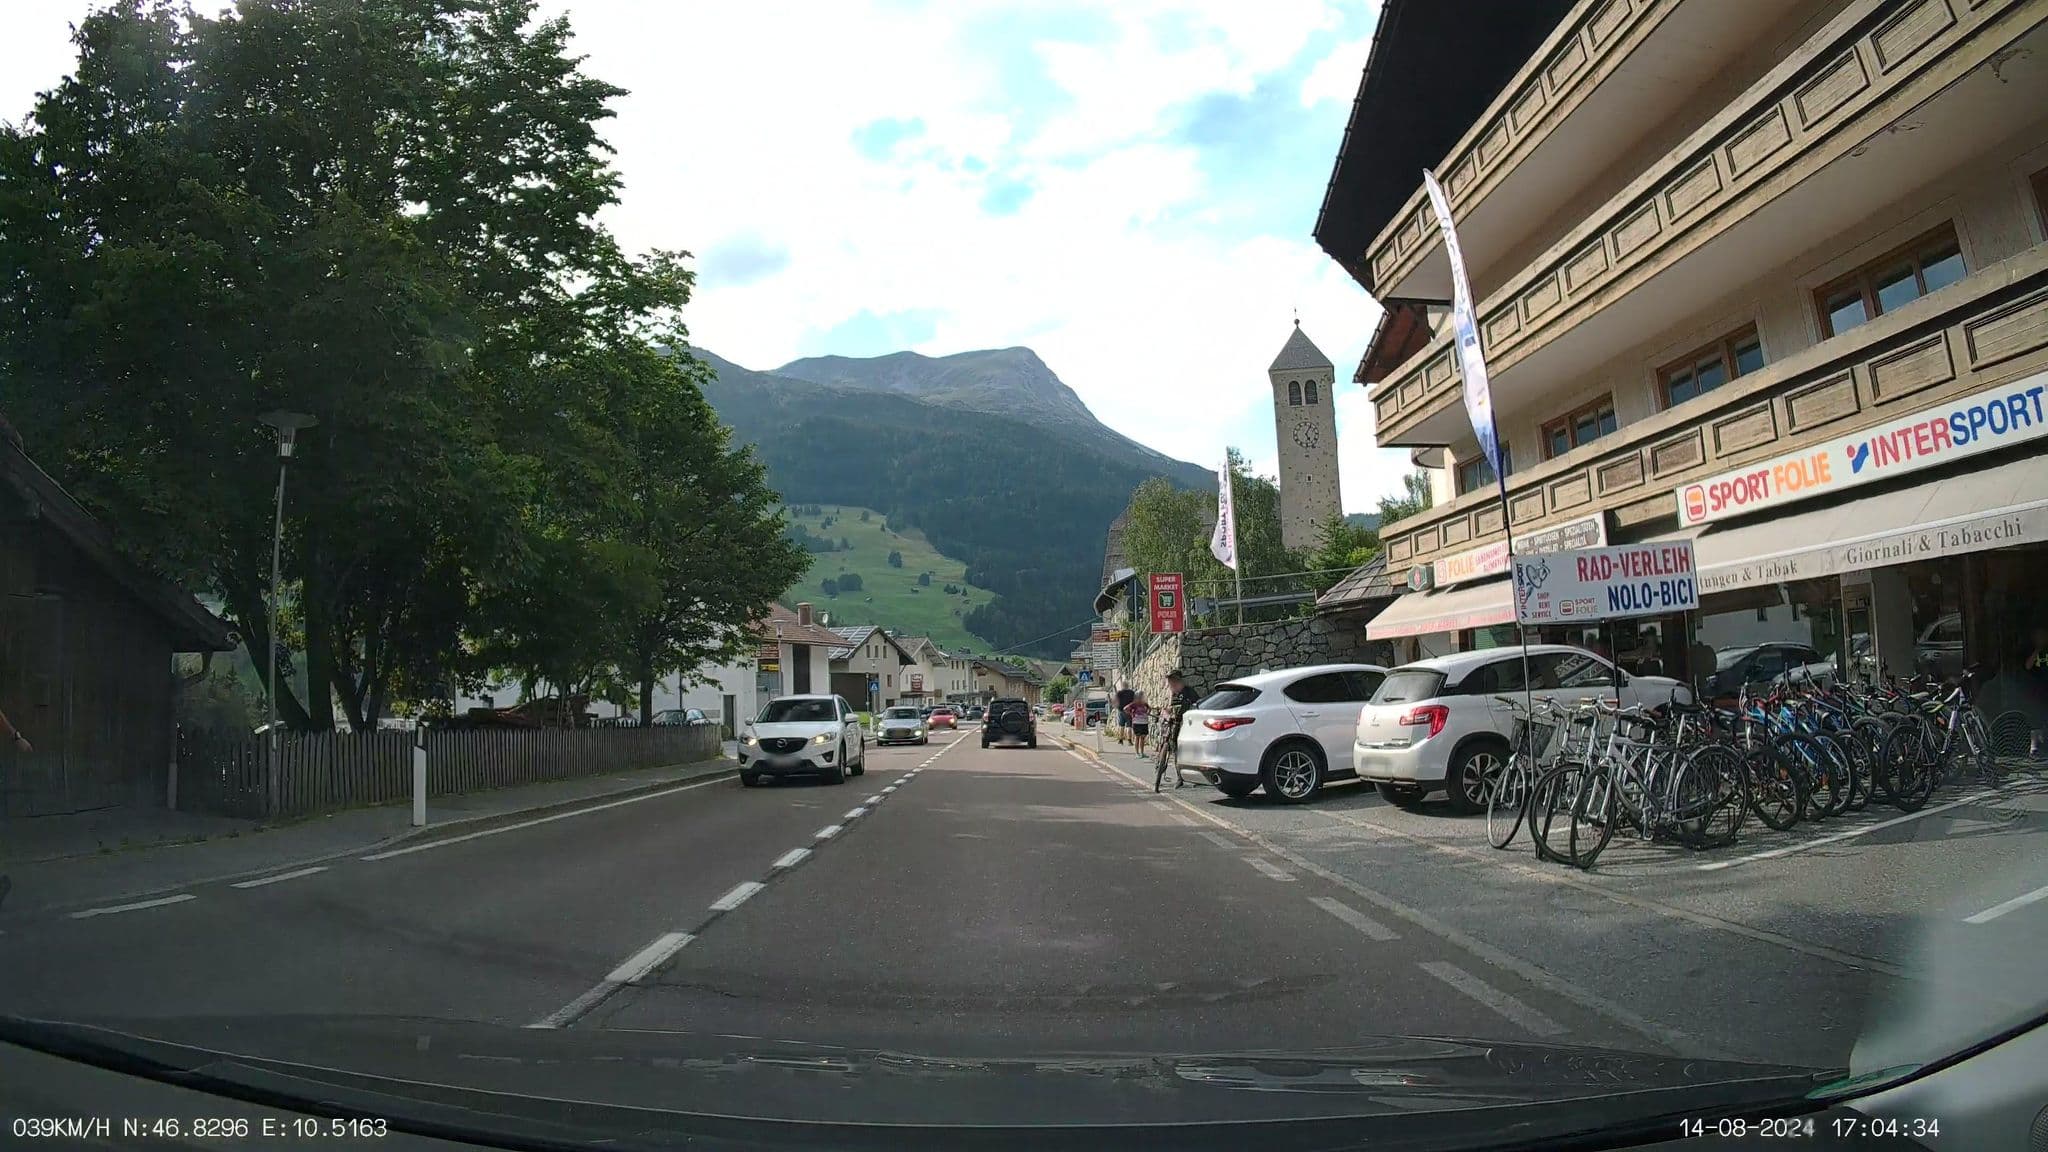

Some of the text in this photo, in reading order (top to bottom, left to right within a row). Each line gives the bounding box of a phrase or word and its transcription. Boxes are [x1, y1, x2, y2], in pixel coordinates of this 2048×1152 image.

[1871, 387, 2046, 468] INTERSPORT
[1709, 452, 1832, 512] SPORT FOLIE
[1846, 518, 2023, 566] Giornali & Tabacchi
[1576, 550, 1690, 583] RAD-VERLEIH
[1741, 566, 1753, 581] &
[1757, 560, 1798, 584] Tabak
[1576, 605, 1599, 614] FOLIE
[1607, 578, 1694, 612] NOLO-BICI
